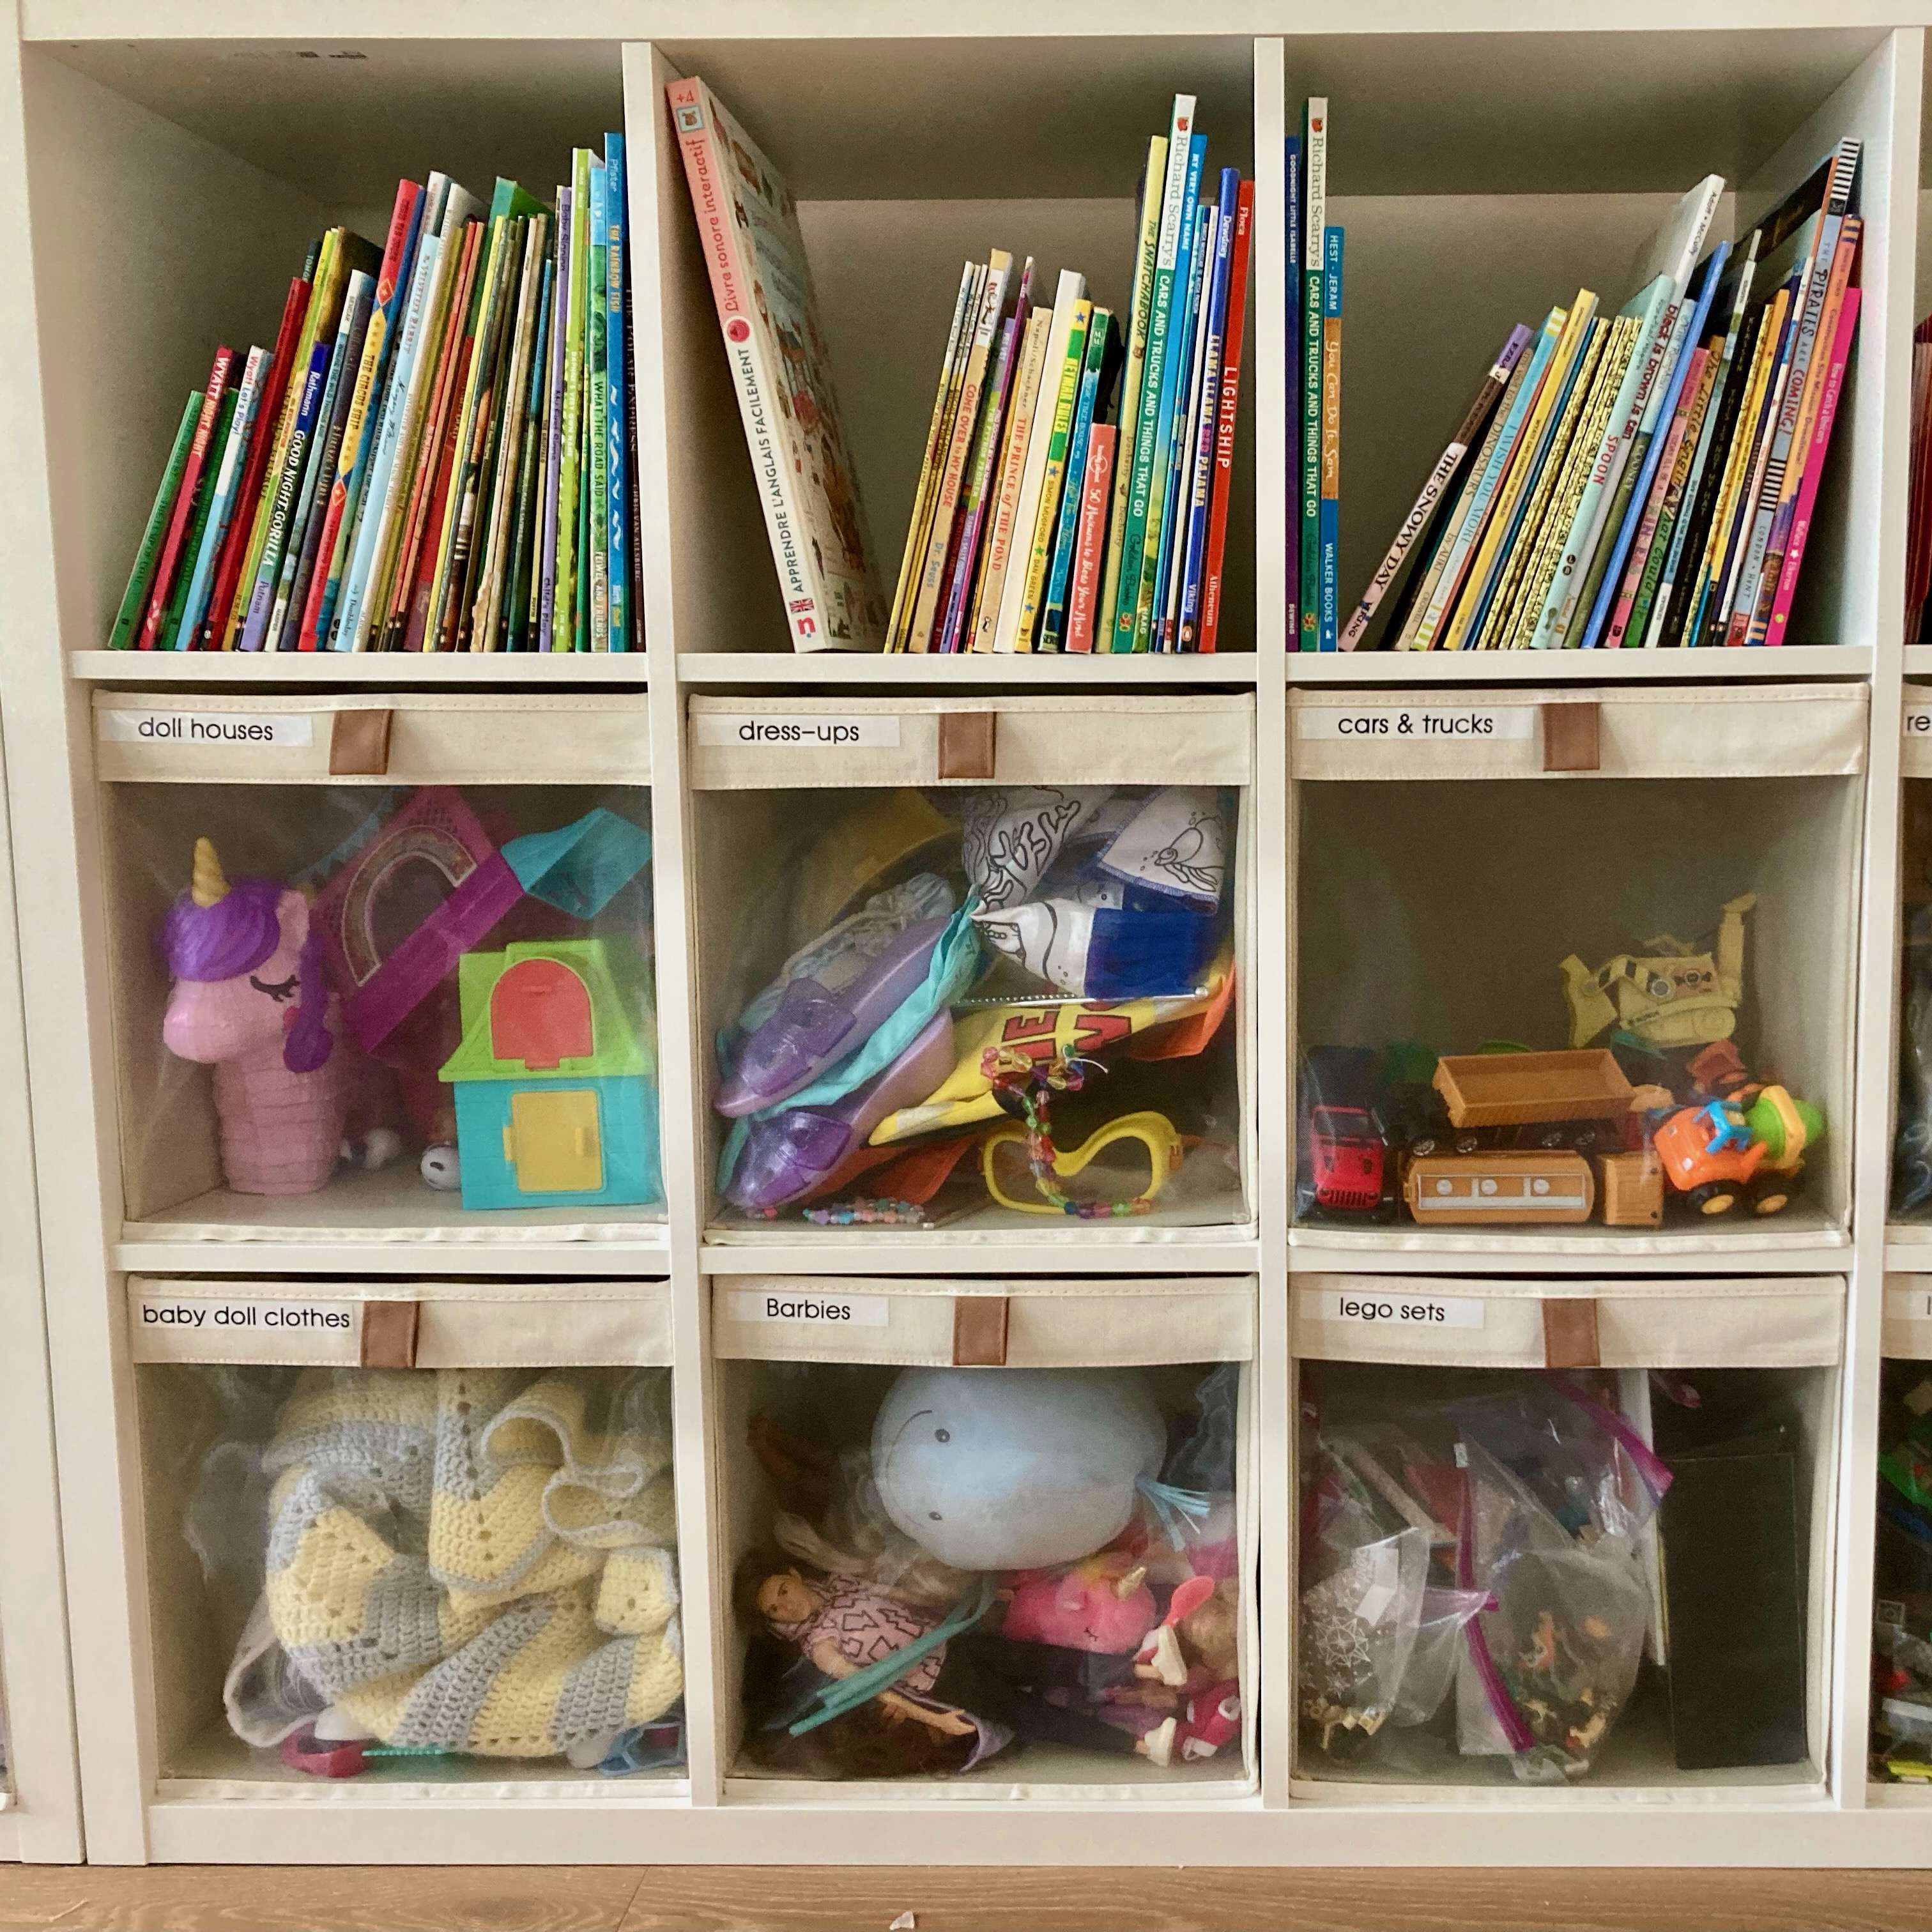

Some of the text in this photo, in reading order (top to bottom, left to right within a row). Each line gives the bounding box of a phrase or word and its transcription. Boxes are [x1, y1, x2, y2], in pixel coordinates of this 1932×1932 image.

[610, 159, 618, 191] Pfister
[1160, 135, 1188, 267] Richard Scarry's
[1181, 153, 1199, 250] MY VERY OWN NAME
[1308, 137, 1323, 266] Richard Scarry's
[558, 204, 569, 271] Baby Signing
[685, 136, 739, 313] Livre sonore interactif
[1217, 215, 1231, 258] Dewdney
[1238, 206, 1248, 235] Floca
[610, 224, 619, 312] THE RAINBOW FISH
[1135, 219, 1156, 339] THE SNATCHABOOK
[1328, 234, 1338, 309] HEST JERAM
[1156, 275, 1170, 307] CARS
[1309, 276, 1319, 307] CARS
[1800, 266, 1828, 337] PIRATES
[1153, 310, 1166, 336] AND
[1309, 310, 1319, 337] AND
[243, 355, 259, 385] Wyatt
[361, 353, 374, 372] THE
[1147, 340, 1163, 388] TRUCKS
[1206, 334, 1220, 377] LLAMA
[1308, 341, 1319, 388] TRUCKS
[1326, 340, 1338, 367] You
[1703, 350, 1721, 380] The
[1326, 372, 1337, 398] Can
[1509, 368, 1525, 390] visit
[1621, 303, 1679, 441] black is brown is tan
[190, 355, 229, 457] WYATT NIGHT NIGHT
[300, 371, 321, 417] Rathmann
[354, 374, 370, 406] CIRCUS
[961, 383, 977, 413] COME
[1053, 357, 1078, 433] NEYMAR RULES
[1144, 391, 1156, 416] AND
[1201, 381, 1216, 424] LLAMA
[1308, 392, 1317, 416] AND
[1504, 388, 1516, 402] to
[1779, 367, 1805, 435] COMING!
[229, 410, 245, 435] Play!
[348, 407, 363, 431] SHIP
[1216, 366, 1237, 468] LIGHTSHIP
[1327, 405, 1337, 424] Do
[1496, 402, 1510, 419] the
[1687, 383, 1712, 433] Little
[594, 381, 603, 496] WHAT THE ROAD SAID
[955, 415, 970, 443] OVER
[1014, 417, 1026, 441] THE
[287, 429, 306, 467] GOOD
[949, 455, 962, 471] MY
[1324, 444, 1337, 480] Sam
[1463, 421, 1504, 498] DINOSAURS
[1490, 430, 1514, 470] WISH
[1592, 434, 1619, 485] SPOON
[737, 347, 804, 594] APPRENDRE L'ANGLAIS FACILEMENT
[1006, 446, 1021, 488] PRINCE
[1135, 466, 1148, 496] THAT
[1193, 456, 1208, 508] PAJAMA
[1307, 466, 1316, 496] THAT
[1667, 439, 1696, 498] Engine
[941, 473, 958, 507] HOUSE
[1000, 493, 1013, 509] of
[1088, 487, 1101, 503] 50
[1476, 472, 1496, 503] YOU
[997, 510, 1009, 534] THE
[1037, 480, 1055, 542] SIMON MUGFORD
[1132, 500, 1144, 517] GO
[1306, 500, 1315, 516] GO
[1372, 450, 1458, 592] THE SNOWY DAY
[1459, 505, 1482, 544] MORE
[262, 510, 286, 566] GORILLA
[991, 539, 1004, 571] POND
[1433, 532, 1457, 572] by ALIKI
[926, 542, 944, 588] Dr. Seuss
[1027, 558, 1040, 599] DAN GREEN
[1324, 542, 1333, 622] WALKER BOOKS
[1643, 546, 1666, 590] Could
[251, 580, 269, 614] Putnam
[540, 577, 550, 633] Child's Play
[594, 551, 604, 637] FEIWEL AND FRIENDS
[1075, 585, 1089, 610] Your
[1184, 583, 1196, 613] Viking
[1206, 574, 1218, 626] Atheneum
[1071, 610, 1086, 637] Mind
[1346, 599, 1373, 638] VIKING
[138, 717, 273, 741] doll houses
[739, 721, 859, 744] dress-ups
[1338, 714, 1493, 734] cars & trucks
[1907, 716, 1931, 731] re
[143, 1305, 349, 1328] baby doll clothes
[767, 1298, 850, 1321] Barbies
[1340, 1297, 1445, 1321] lego sets
